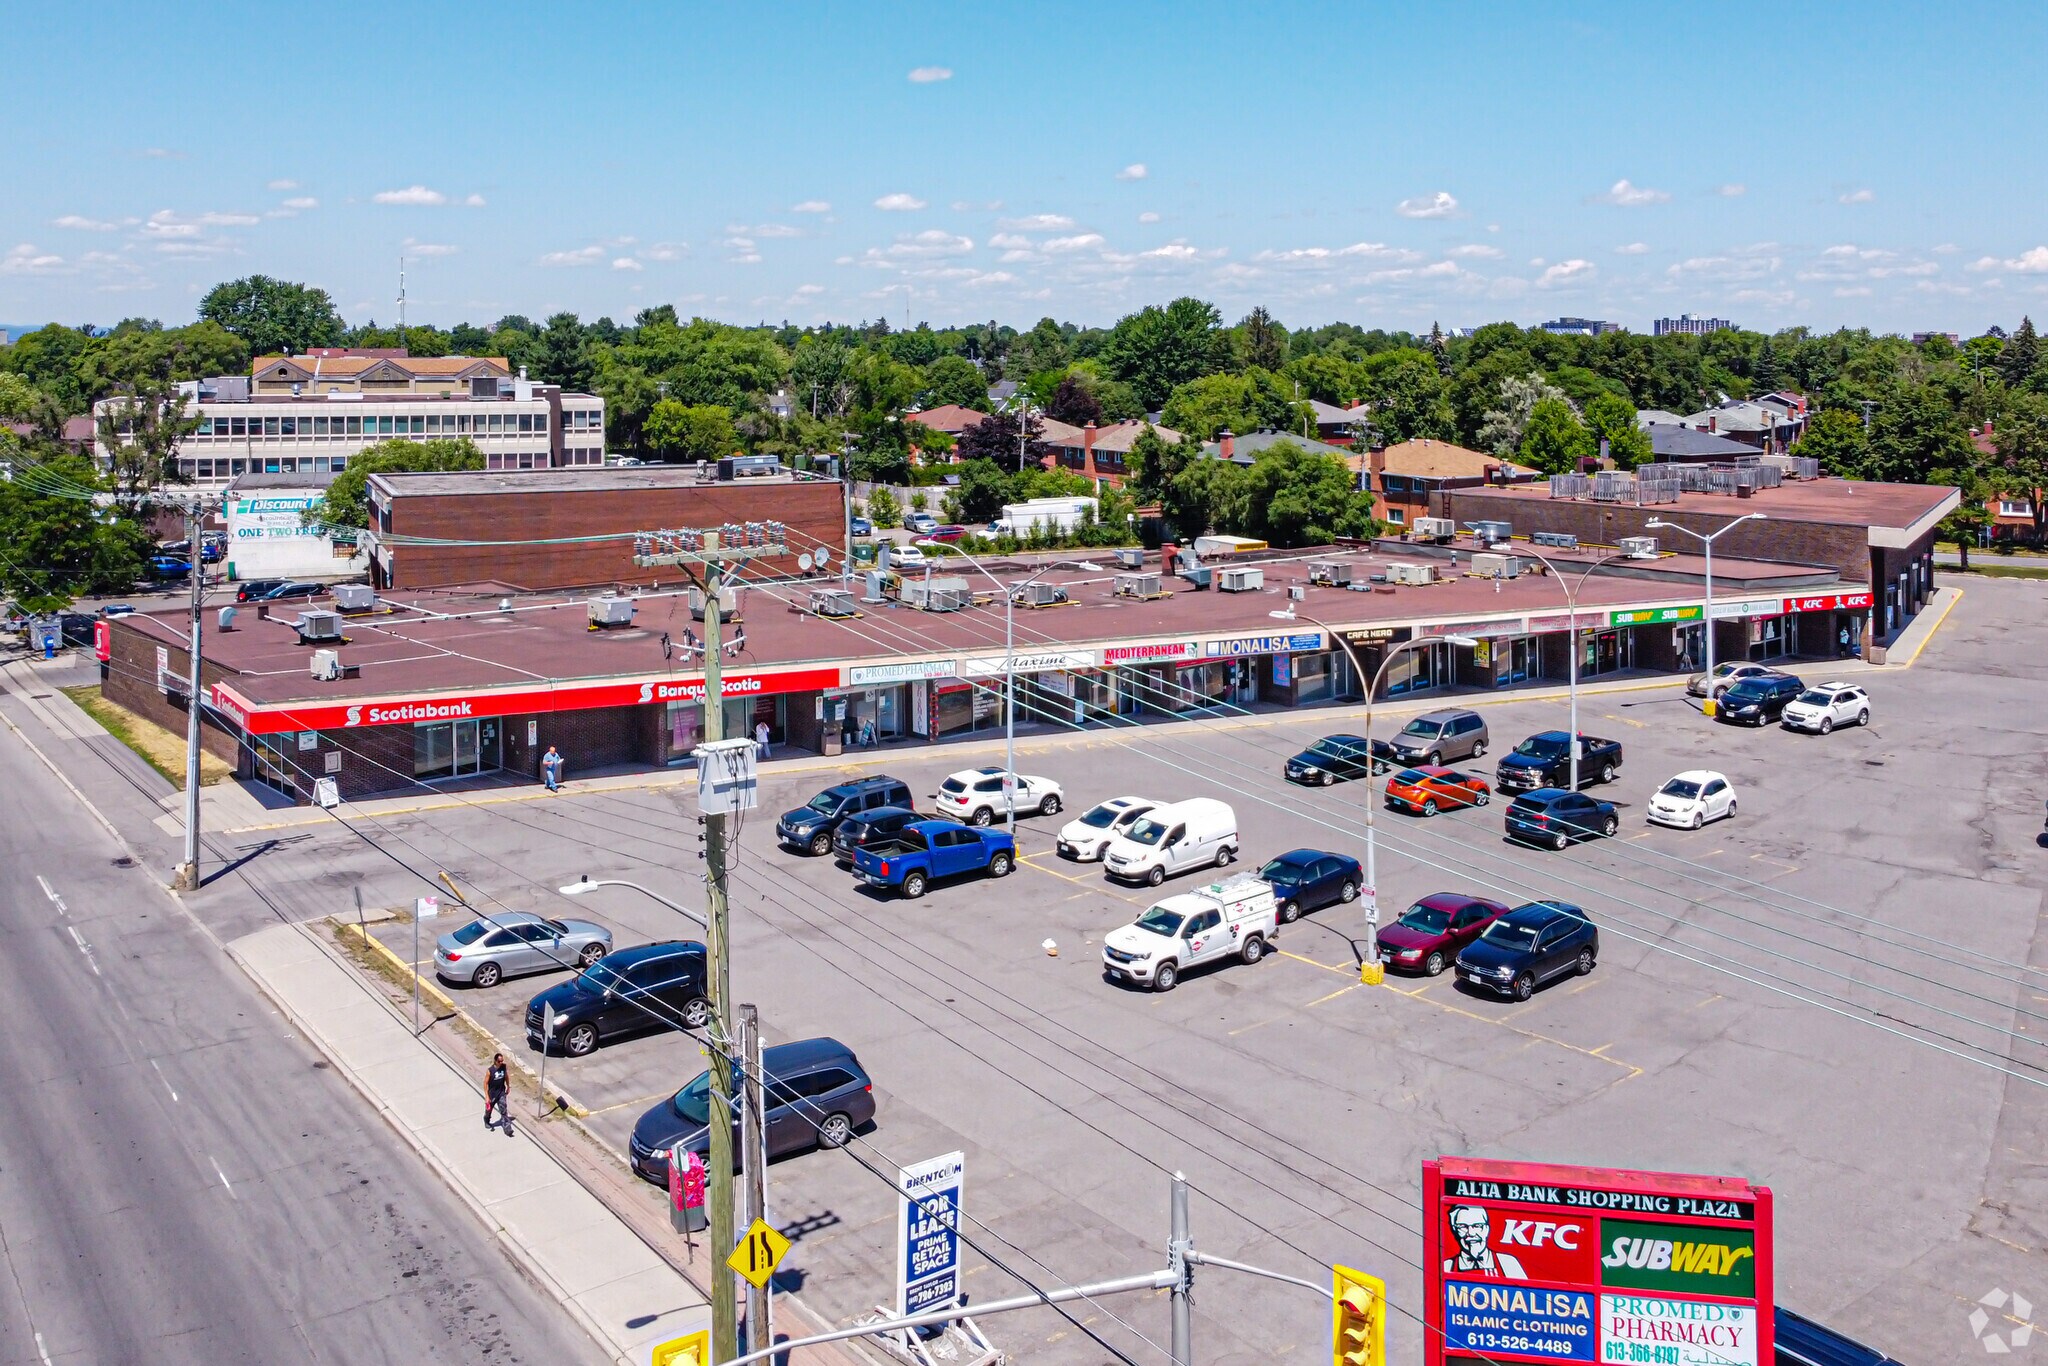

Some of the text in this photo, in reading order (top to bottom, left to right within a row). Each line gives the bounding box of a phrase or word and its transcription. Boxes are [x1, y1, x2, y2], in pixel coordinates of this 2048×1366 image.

[254, 500, 307, 510] Discount
[238, 528, 264, 538] ONE
[267, 527, 292, 536] TWO
[1803, 596, 1868, 609] KFC KFC
[1616, 611, 1654, 623] SUBWAY
[1661, 607, 1698, 620] SUBWAY
[1105, 643, 1186, 659] MEDITERRANEAN
[1220, 637, 1291, 655] MONALISA
[866, 661, 954, 678] PROMED PHARMACY
[658, 685, 705, 700] Banqu
[369, 701, 473, 722] Scotiabank
[918, 1194, 949, 1220] FOR
[1456, 1180, 1742, 1218] ALTA BANK SHOPPING PLAZA
[910, 1210, 955, 1240] LEASE
[1500, 1219, 1581, 1250] KFC
[912, 1241, 951, 1264] RETAIL
[917, 1232, 947, 1251] PRIME
[914, 1252, 950, 1275] SPACE
[1601, 1236, 1754, 1276] SUBWAY
[1448, 1284, 1591, 1319] MONALISA
[1612, 1296, 1725, 1322] PROMED
[1451, 1313, 1588, 1337] ISLAMIC CLOTHING
[1611, 1316, 1743, 1348] PHARMACY
[1467, 1332, 1572, 1354] 613-526-4489
[1605, 1341, 1680, 1366] 613-366-8787
